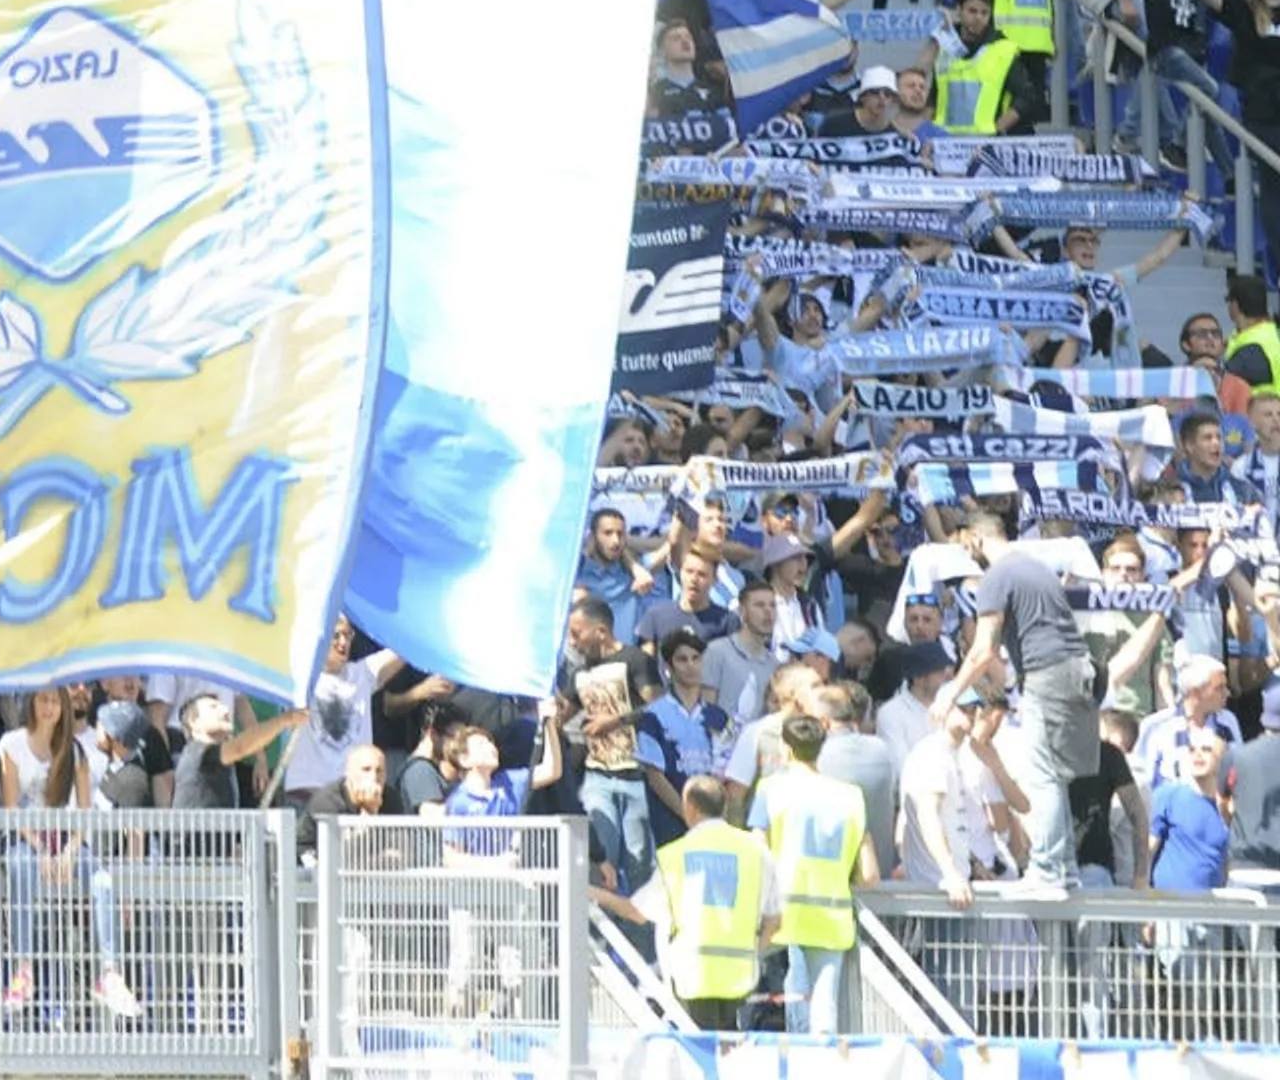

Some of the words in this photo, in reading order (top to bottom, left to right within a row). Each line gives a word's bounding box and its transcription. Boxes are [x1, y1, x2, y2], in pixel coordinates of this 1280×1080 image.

[645, 120, 712, 146] azio
[746, 141, 841, 160] LAZIO
[1001, 150, 1126, 180] RRIDUCIBILI
[997, 297, 1071, 321] LAZIO
[905, 327, 993, 355] LAZIO
[621, 351, 659, 373] tutte
[854, 384, 948, 413] LAZIO
